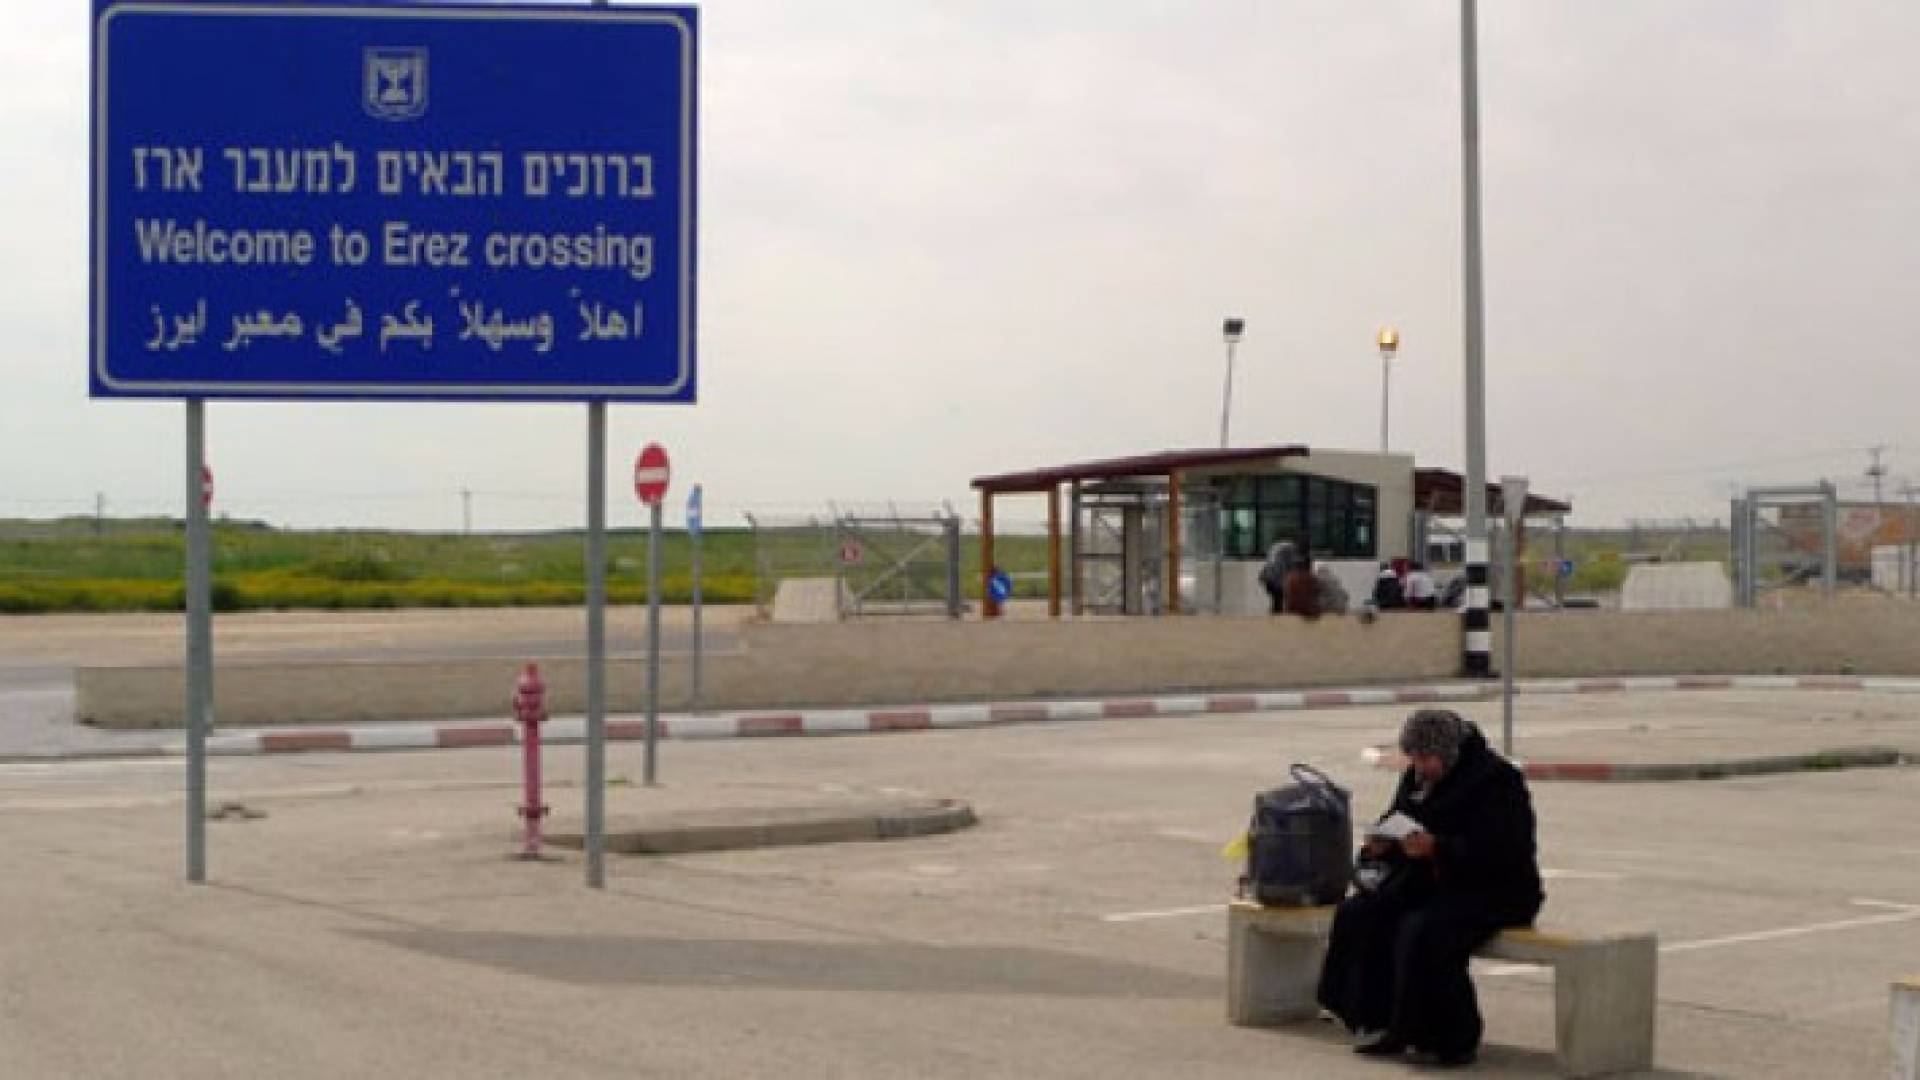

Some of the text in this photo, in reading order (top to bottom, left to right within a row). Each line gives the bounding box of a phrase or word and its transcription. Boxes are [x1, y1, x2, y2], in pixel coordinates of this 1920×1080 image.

[133, 142, 654, 197] ברוכים הבאים למעבר ארז
[135, 219, 653, 279] Welcome to Erez crossing
[146, 299, 206, 351] ايرز
[222, 311, 303, 351] معبر
[317, 298, 363, 352] في
[380, 300, 432, 350] بكم
